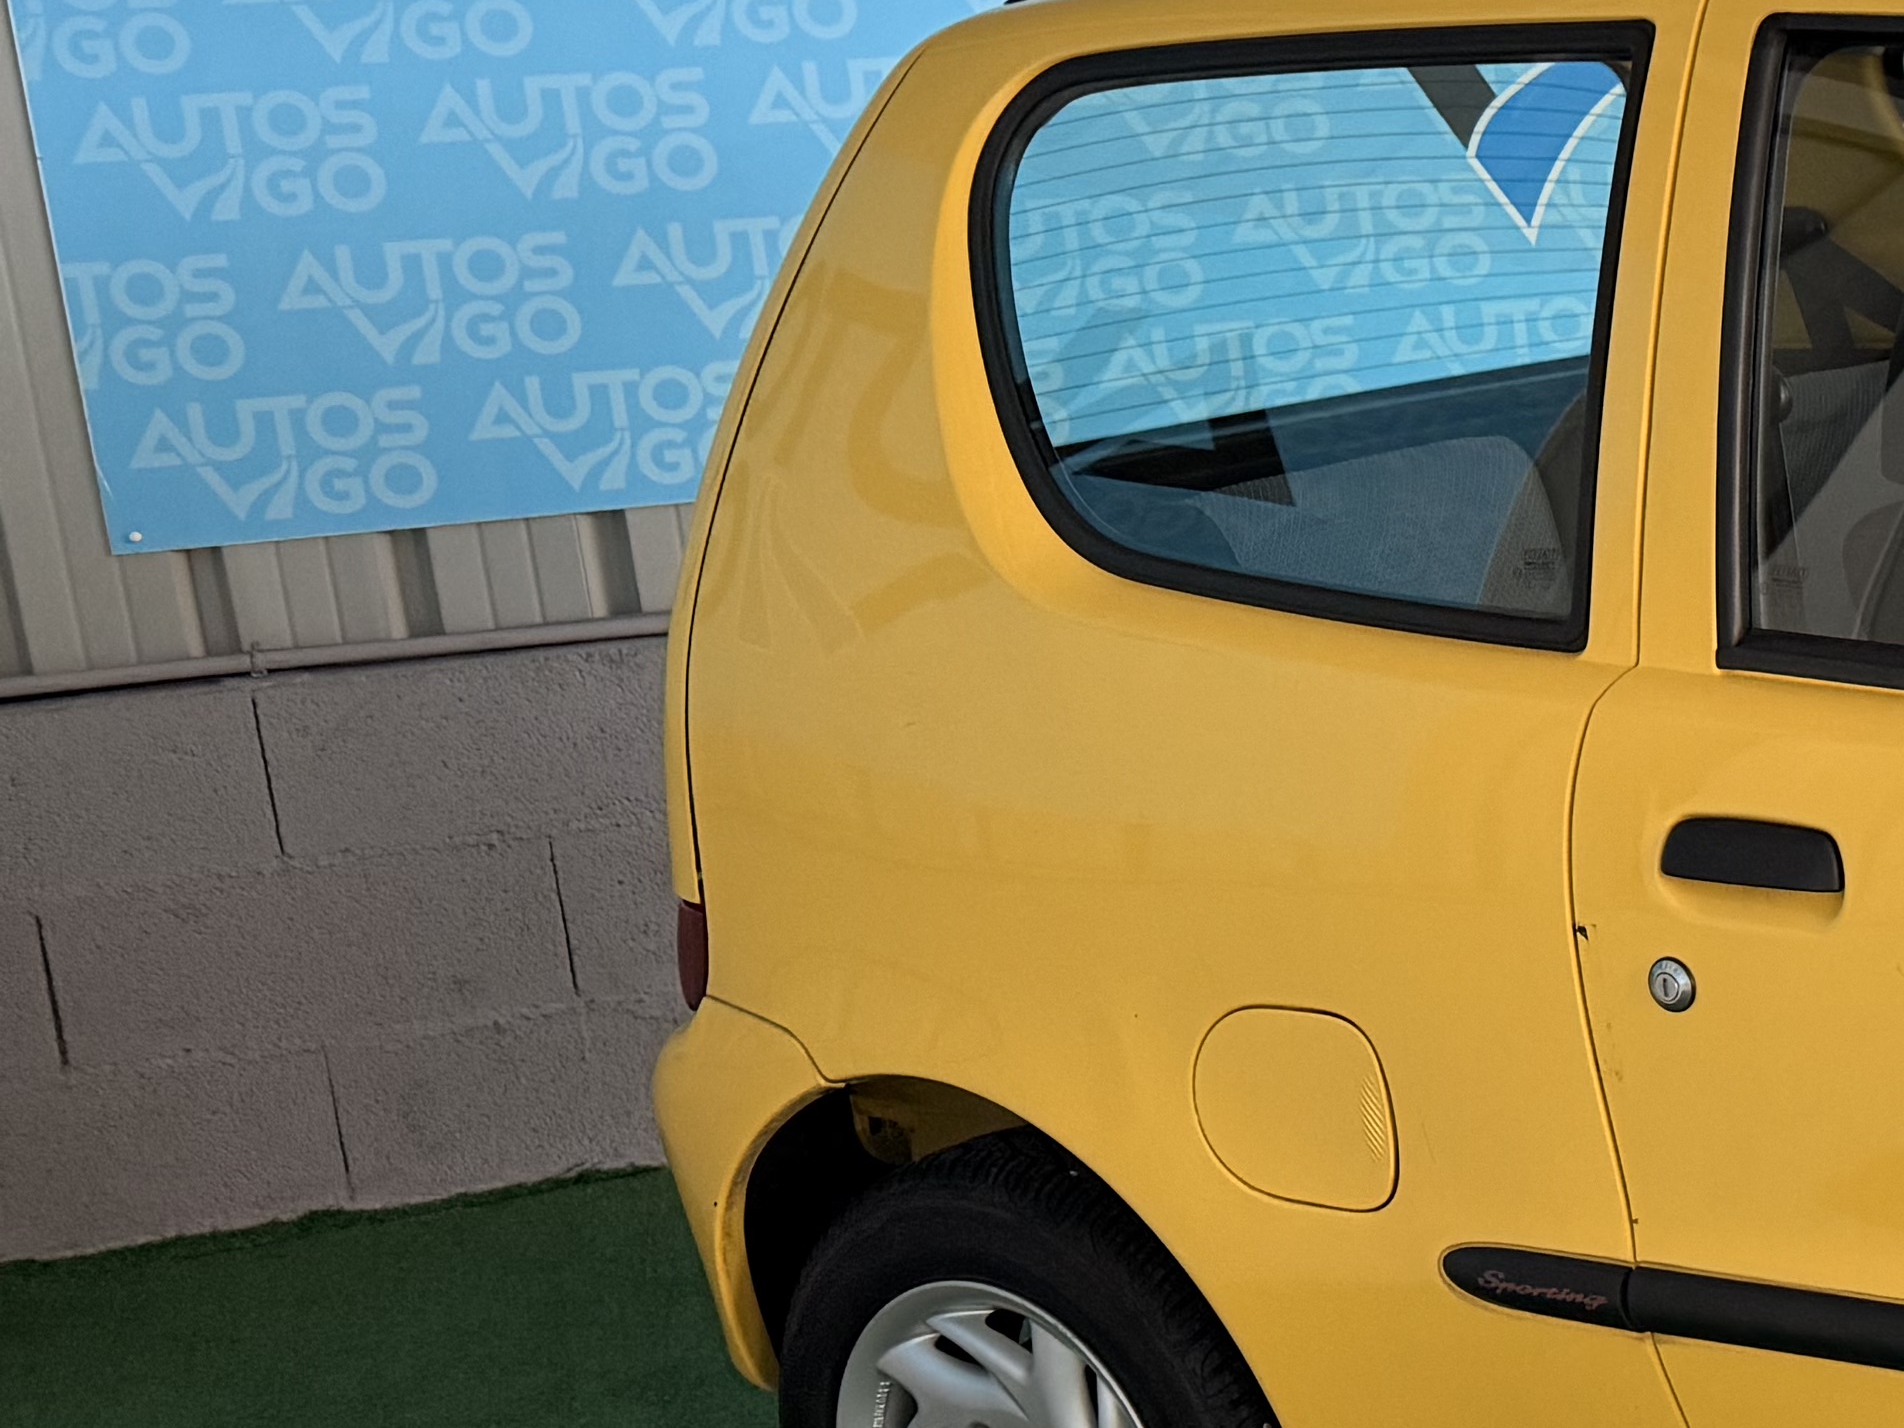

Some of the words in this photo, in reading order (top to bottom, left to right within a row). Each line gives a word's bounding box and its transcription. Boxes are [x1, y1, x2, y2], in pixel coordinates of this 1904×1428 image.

[14, 12, 191, 84] IGO
[73, 86, 377, 165] AUTOS
[418, 68, 708, 144] AUTOS
[1117, 95, 1327, 160] VIGO
[141, 151, 386, 222] VIGO
[483, 131, 716, 200] VIGO
[1230, 172, 1482, 244] AUTOS
[278, 233, 572, 313] AUTOS
[612, 217, 803, 289] AUT
[1287, 230, 1488, 295] VIGO
[59, 256, 236, 326] TOS
[74, 321, 246, 393] IGO
[344, 296, 581, 367] VIGO
[1098, 314, 1355, 389] AUTOS
[1389, 297, 1596, 365] AUTO
[130, 387, 428, 471] AUTOS
[533, 428, 715, 493] VIG
[197, 451, 438, 523] VIGO
[1477, 1269, 1608, 1310] Sporting
